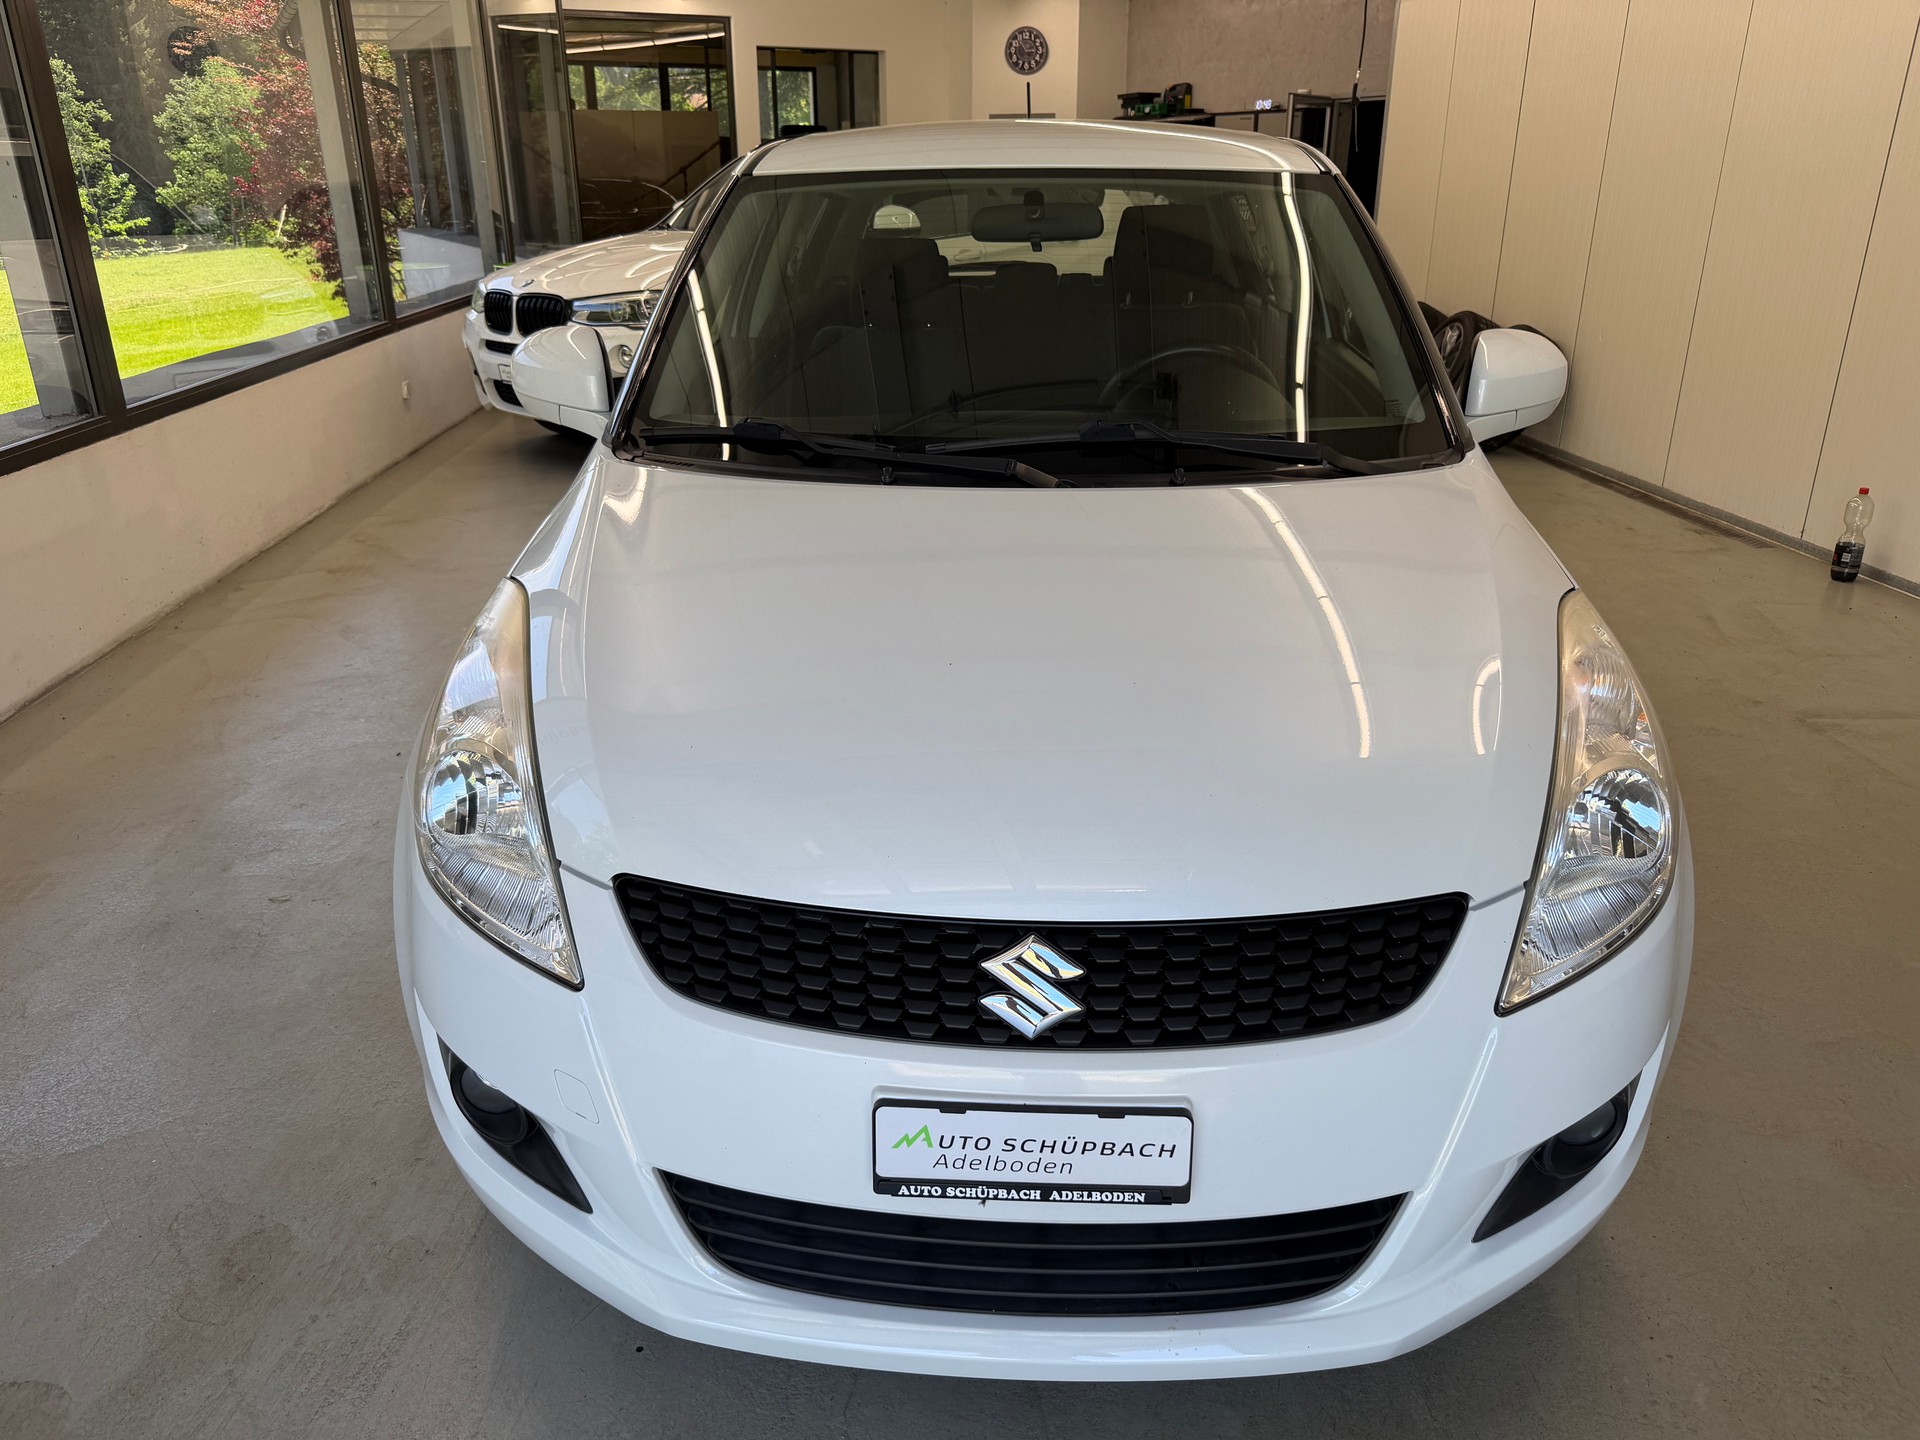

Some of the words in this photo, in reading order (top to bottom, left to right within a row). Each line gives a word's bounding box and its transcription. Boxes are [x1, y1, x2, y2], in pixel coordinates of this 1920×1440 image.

[1001, 1136, 1176, 1158] SCHÜPBACH
[932, 1153, 1073, 1174] Adelboden
[898, 1185, 942, 1196] AUTO
[946, 1186, 1041, 1200] SCHÜPBACH
[1049, 1190, 1146, 1203] ADELBODEN
